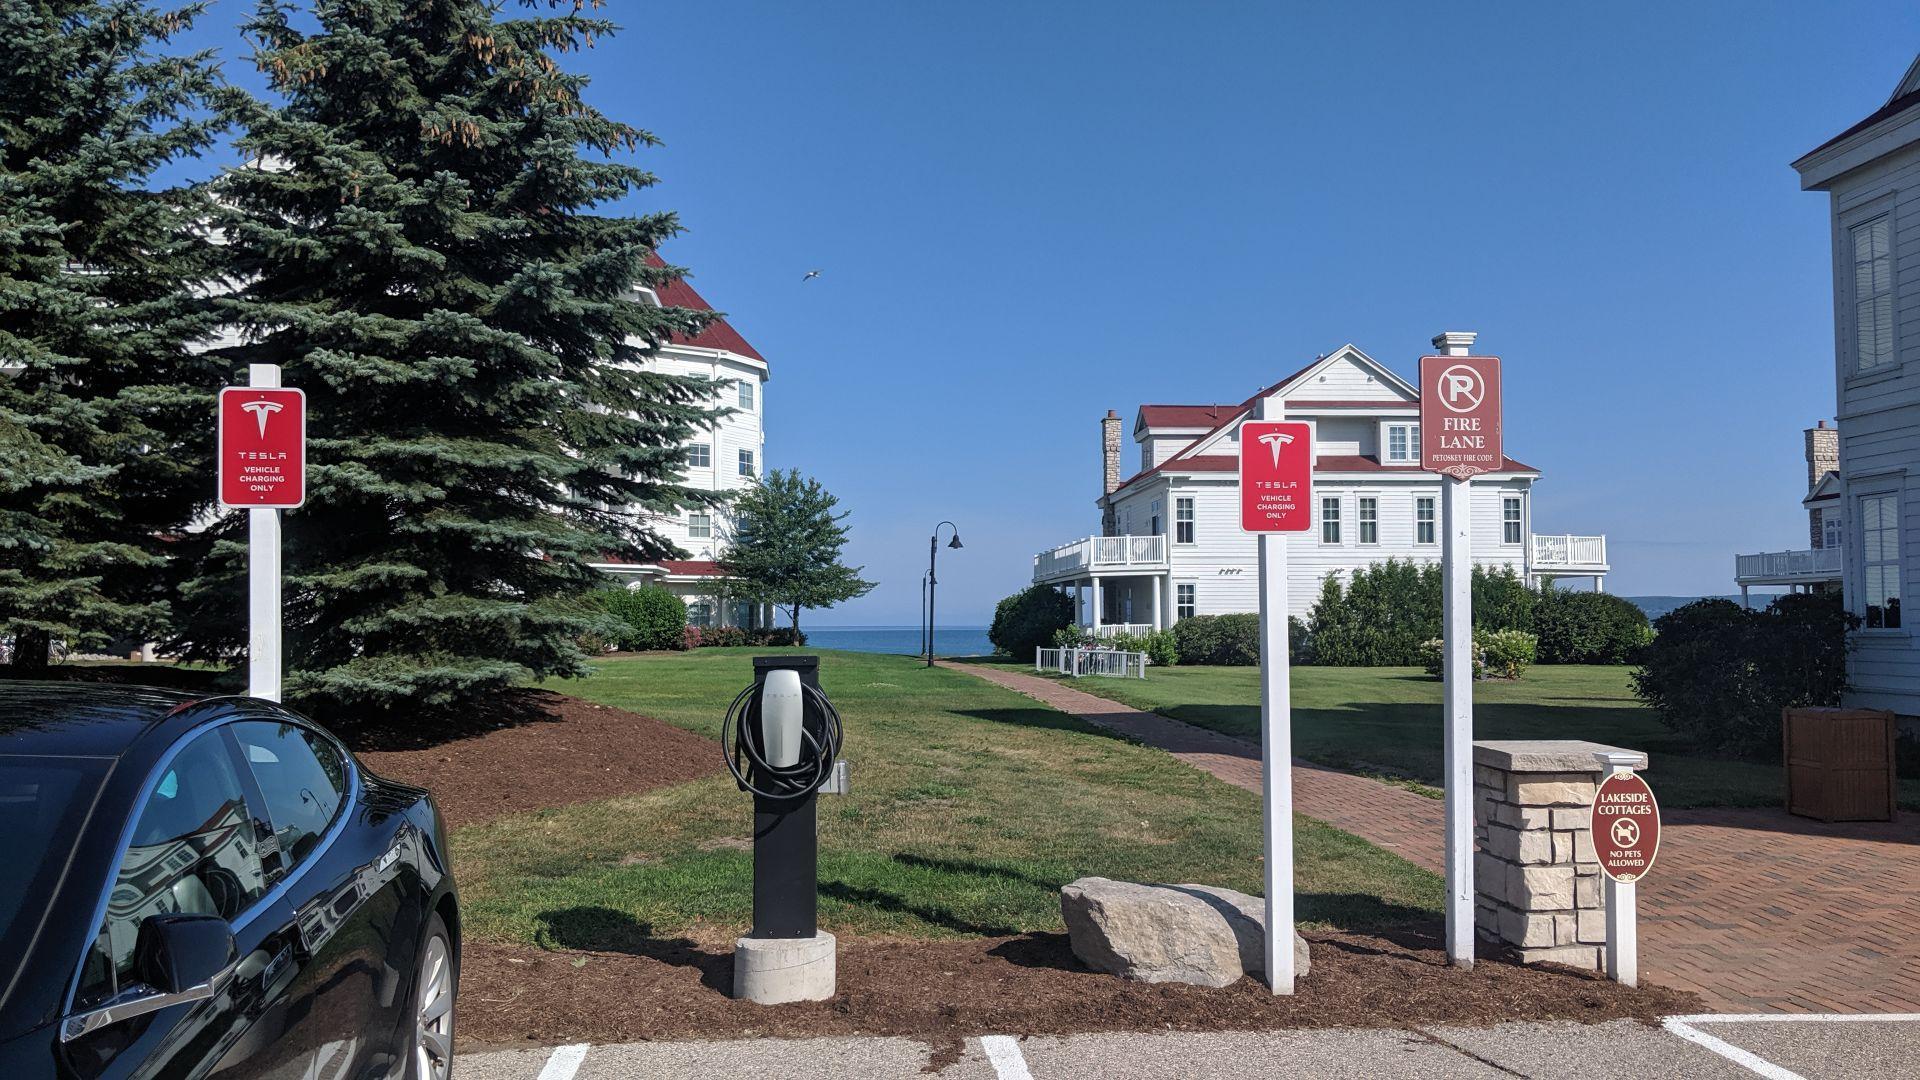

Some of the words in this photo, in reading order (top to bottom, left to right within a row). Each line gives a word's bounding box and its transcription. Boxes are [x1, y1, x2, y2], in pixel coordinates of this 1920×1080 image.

[1444, 418, 1482, 431] FIRE
[1440, 436, 1485, 448] LANE
[238, 452, 286, 460] TESLA
[1601, 793, 1648, 802] LAKESIDE
[1598, 805, 1652, 814] COTTAGES
